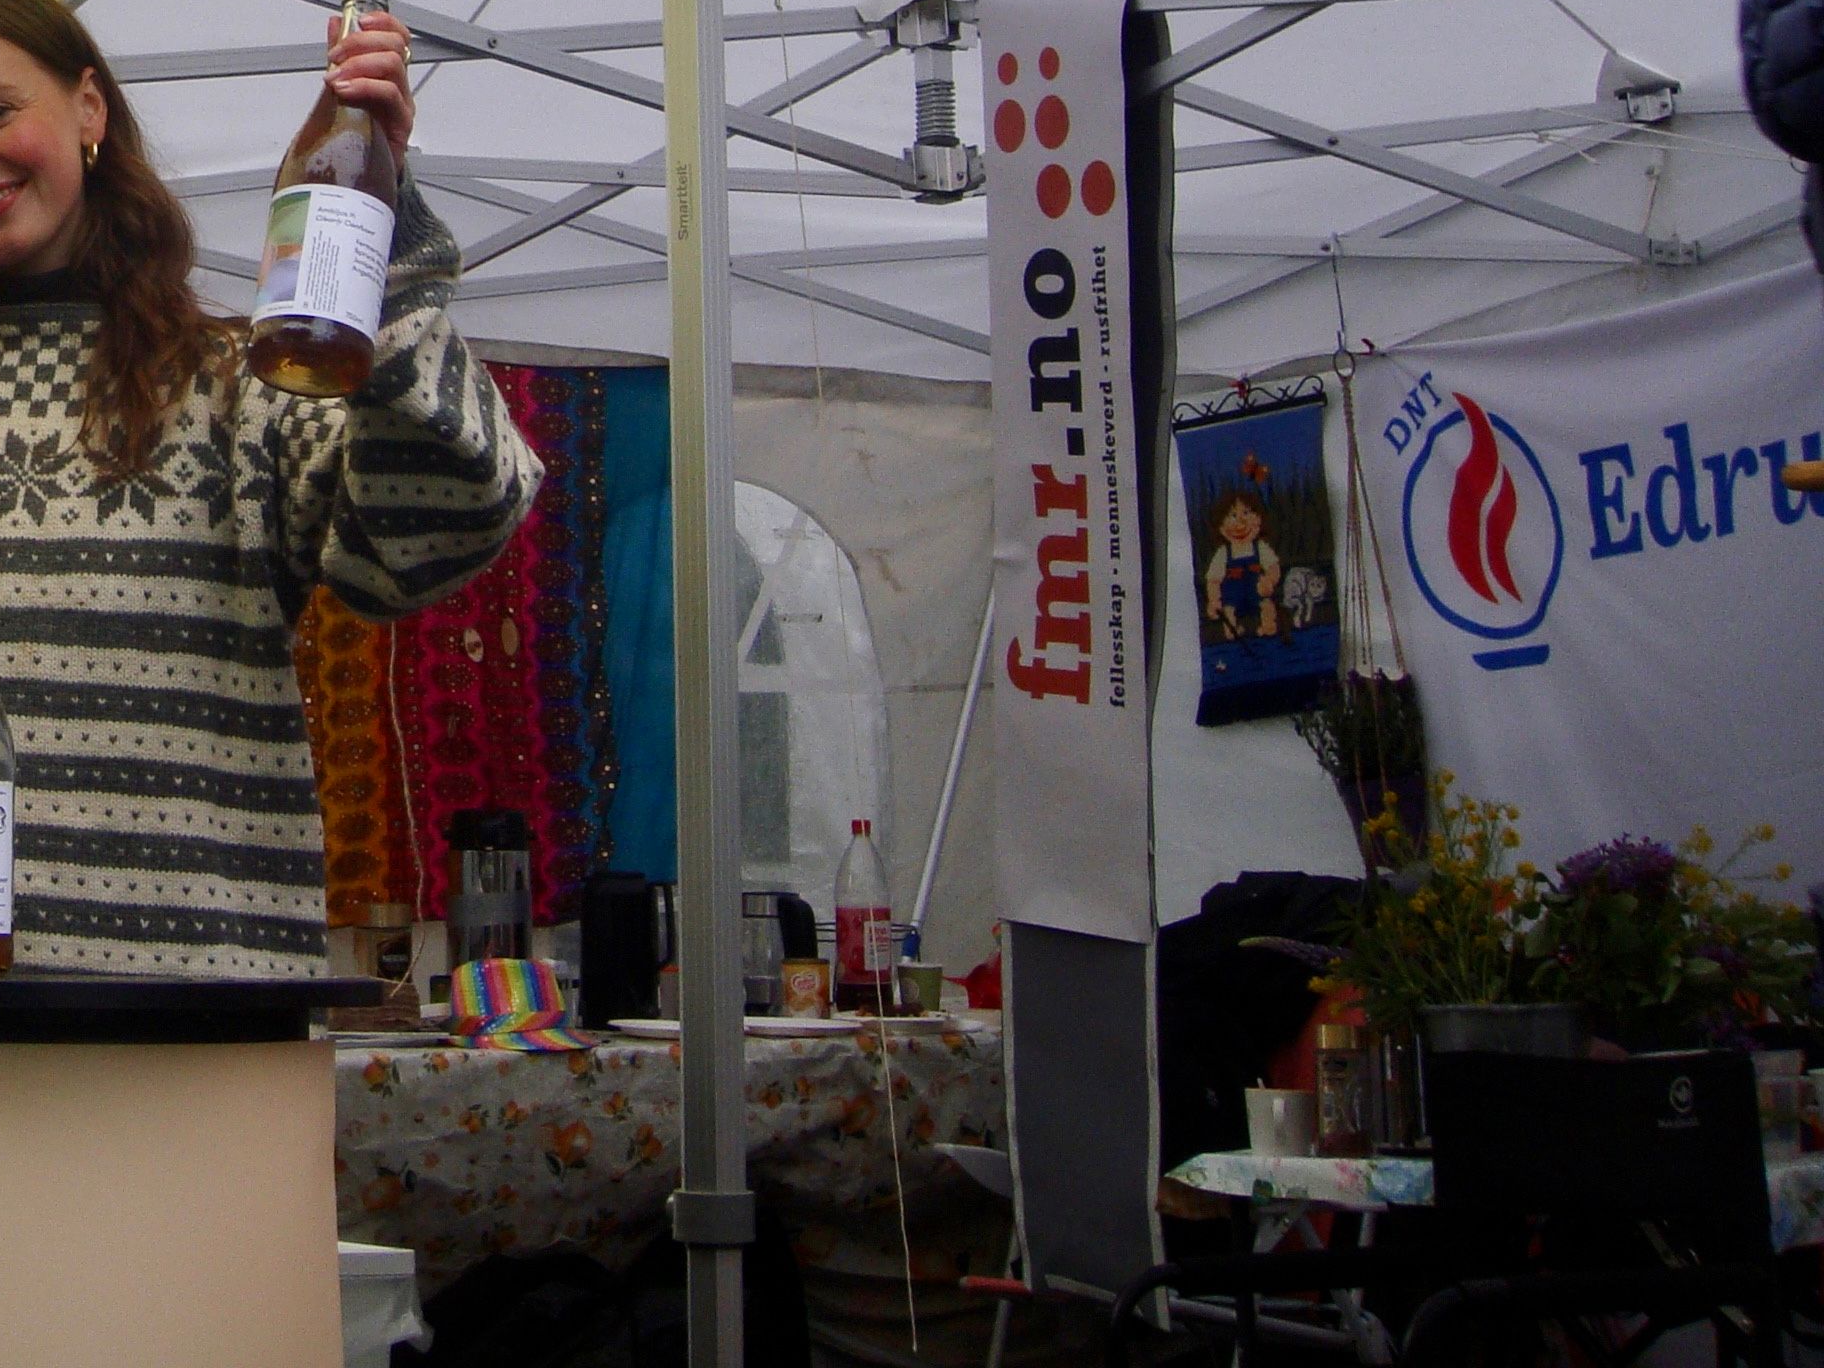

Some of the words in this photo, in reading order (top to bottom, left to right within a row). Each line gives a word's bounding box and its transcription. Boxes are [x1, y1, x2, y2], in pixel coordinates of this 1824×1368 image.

[1091, 245, 1111, 357] rusfrihet
[1099, 381, 1121, 560] menneskeverd
[1382, 371, 1443, 456] DNT
[1007, 248, 1092, 705] fmr.no
[1109, 584, 1126, 708] fellesskap
